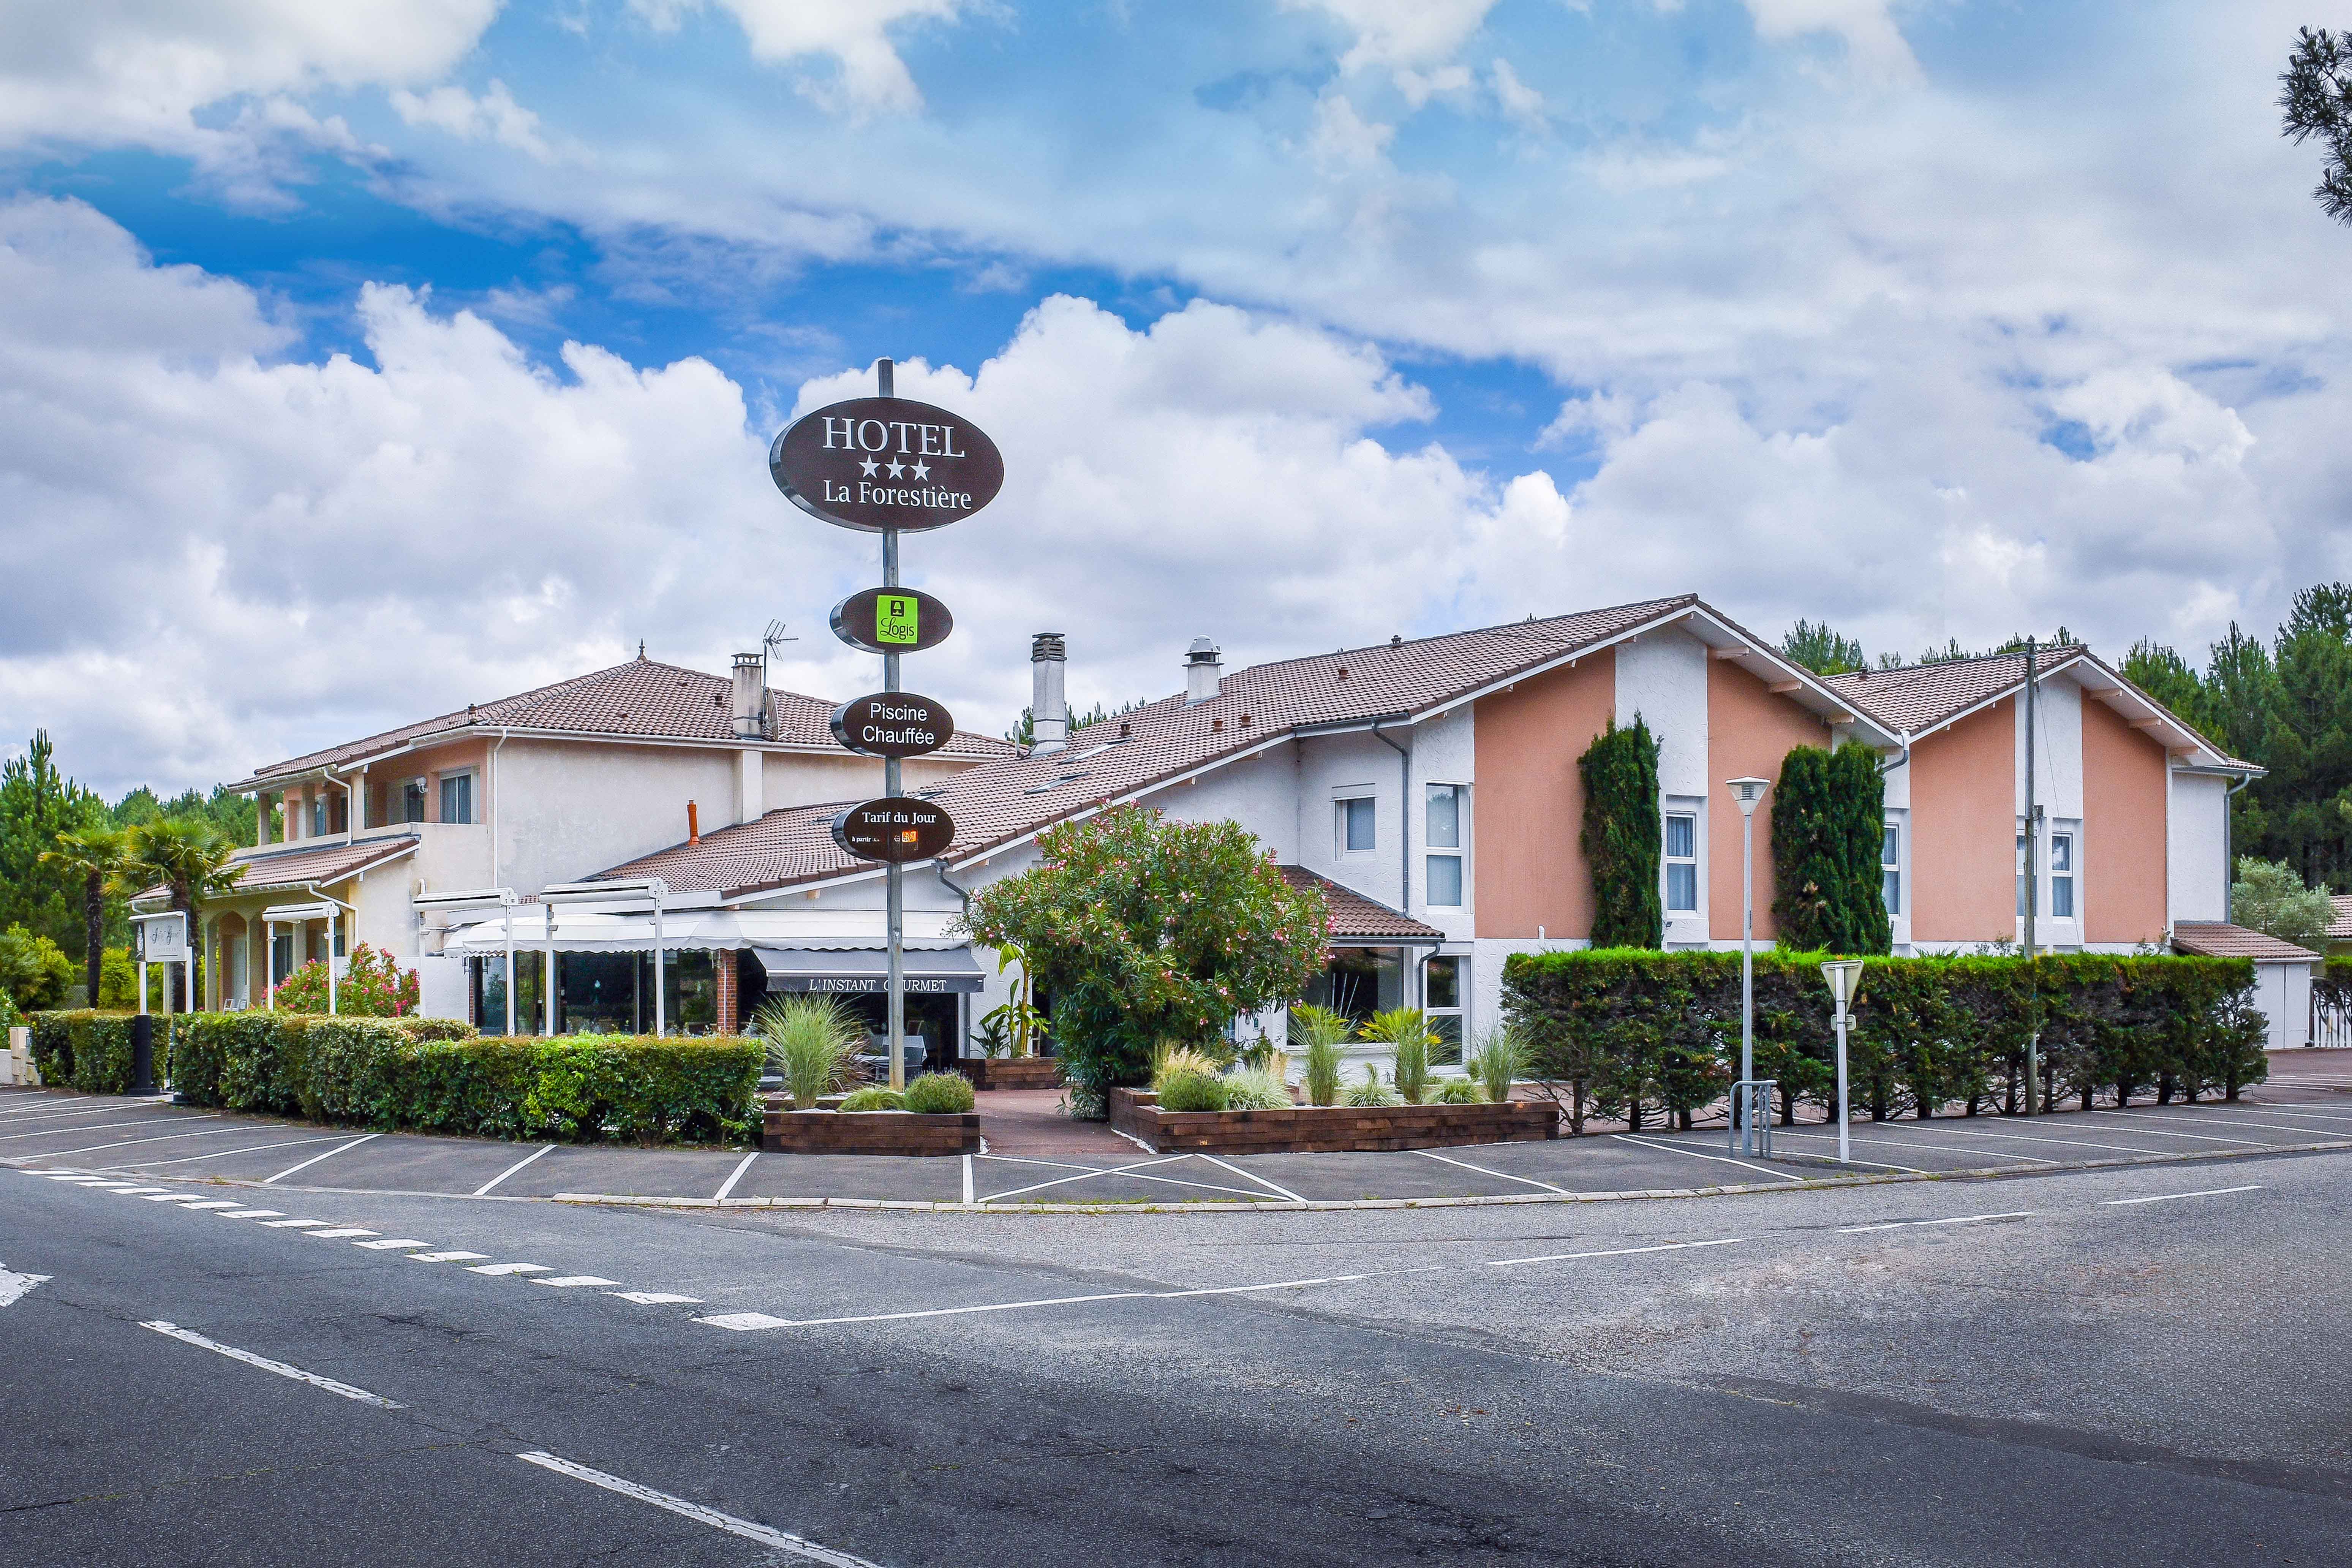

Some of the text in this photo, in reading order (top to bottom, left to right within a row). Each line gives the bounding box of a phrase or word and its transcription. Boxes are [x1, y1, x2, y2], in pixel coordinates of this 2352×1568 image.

[822, 417, 965, 458] HOTEL
[824, 480, 972, 510] La Forestière
[879, 617, 915, 640] Logis
[870, 702, 928, 721] Piscine
[862, 725, 935, 745] Chauffée
[862, 811, 936, 825] Tarif du Jour
[809, 979, 947, 991] L'INSTANT GURMET
